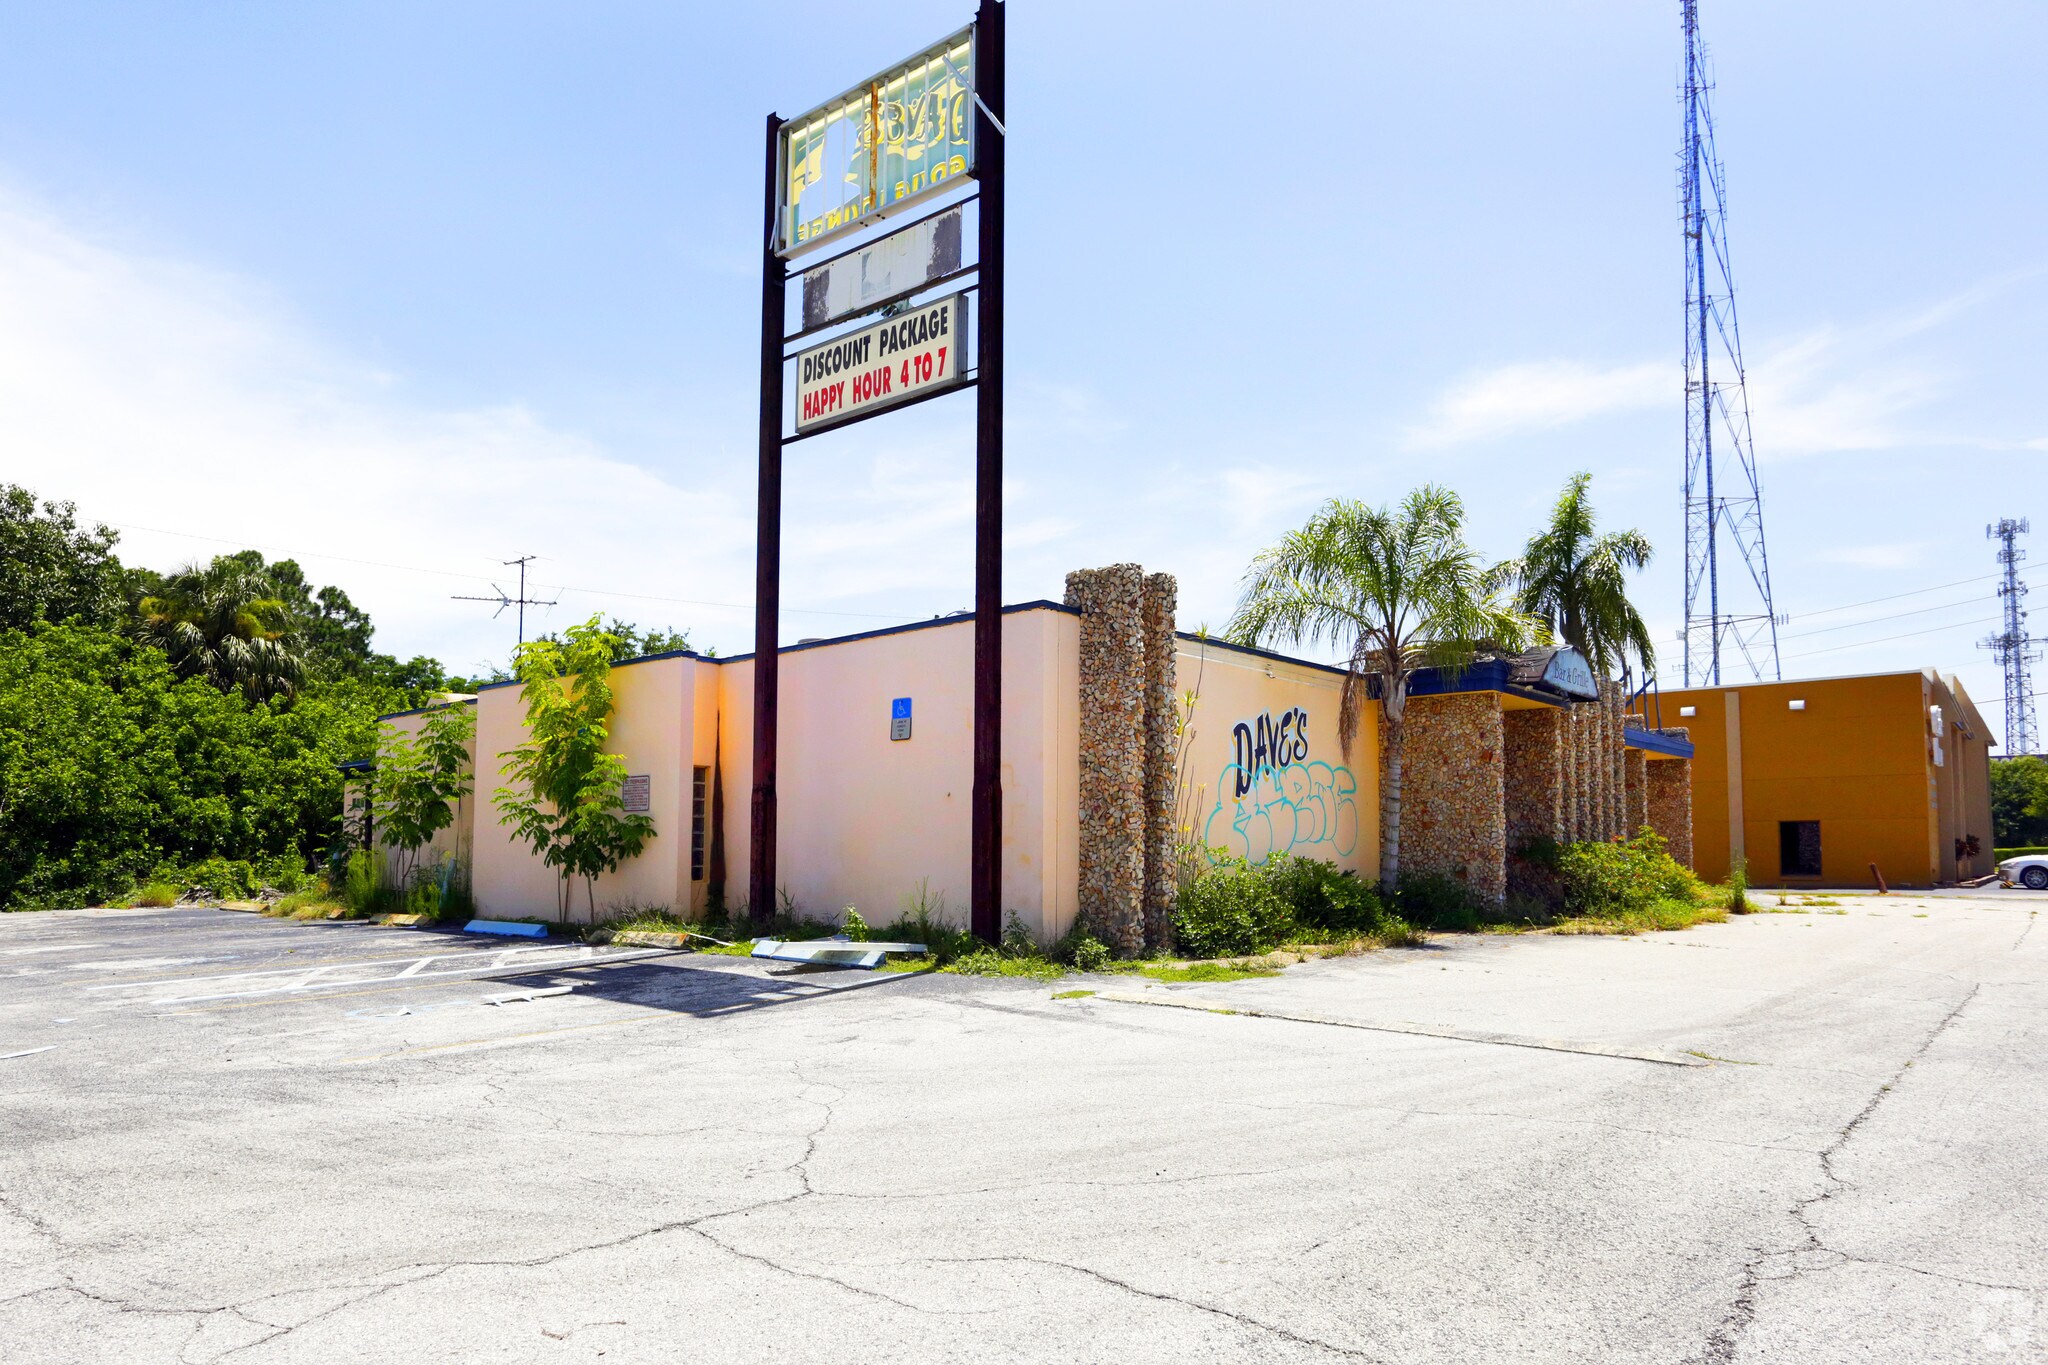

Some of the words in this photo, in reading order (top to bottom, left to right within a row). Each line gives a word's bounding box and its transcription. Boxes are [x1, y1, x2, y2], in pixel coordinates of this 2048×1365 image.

[803, 334, 871, 384] DISCOUNT
[879, 305, 948, 357] PACKAGE
[803, 381, 845, 421] HAPPY
[853, 365, 892, 404] HOUR
[900, 359, 909, 388] 4
[914, 351, 933, 384] TO
[938, 346, 947, 377] 7
[1554, 661, 1567, 682] Bar
[1567, 667, 1572, 683] &
[1233, 707, 1308, 798] DAVE'S
